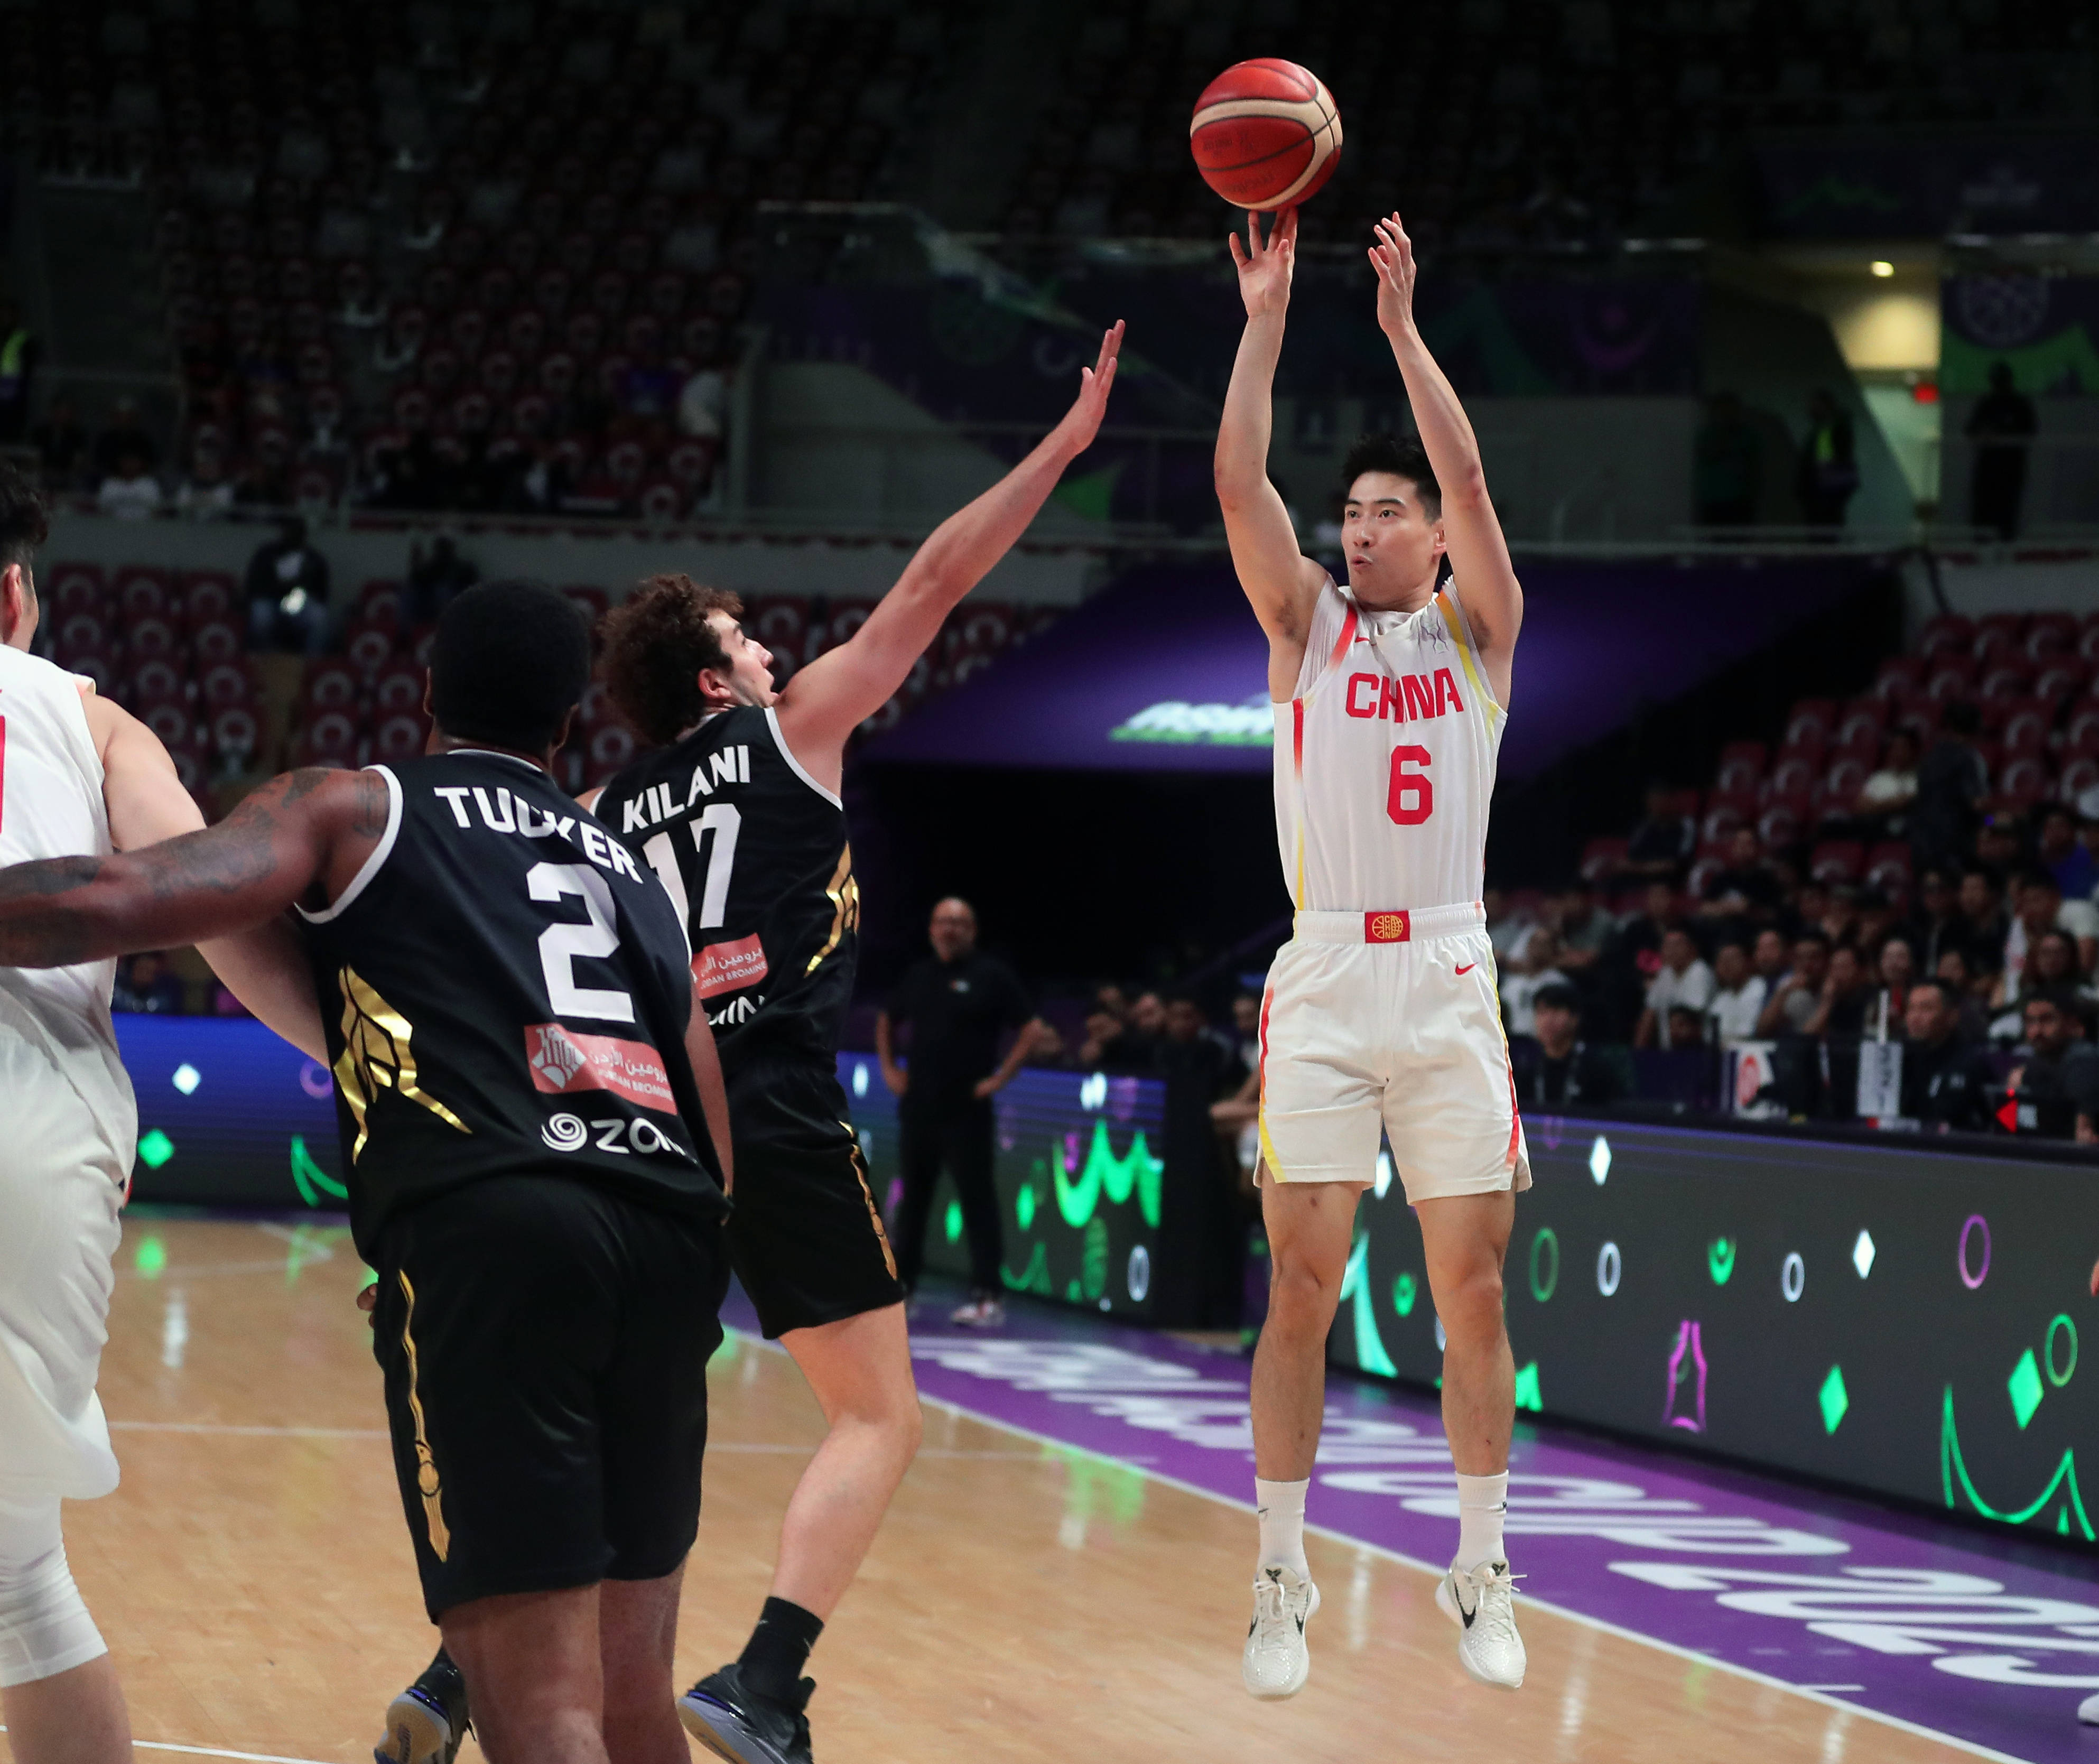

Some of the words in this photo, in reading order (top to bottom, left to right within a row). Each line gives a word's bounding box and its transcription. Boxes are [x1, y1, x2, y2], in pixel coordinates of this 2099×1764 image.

[1345, 667, 1464, 723] CHNA
[623, 745, 751, 834] KILANI
[1387, 745, 1434, 825] 6
[433, 786, 644, 884] TUCKER
[642, 803, 742, 930] 17
[526, 861, 636, 1024] 2
